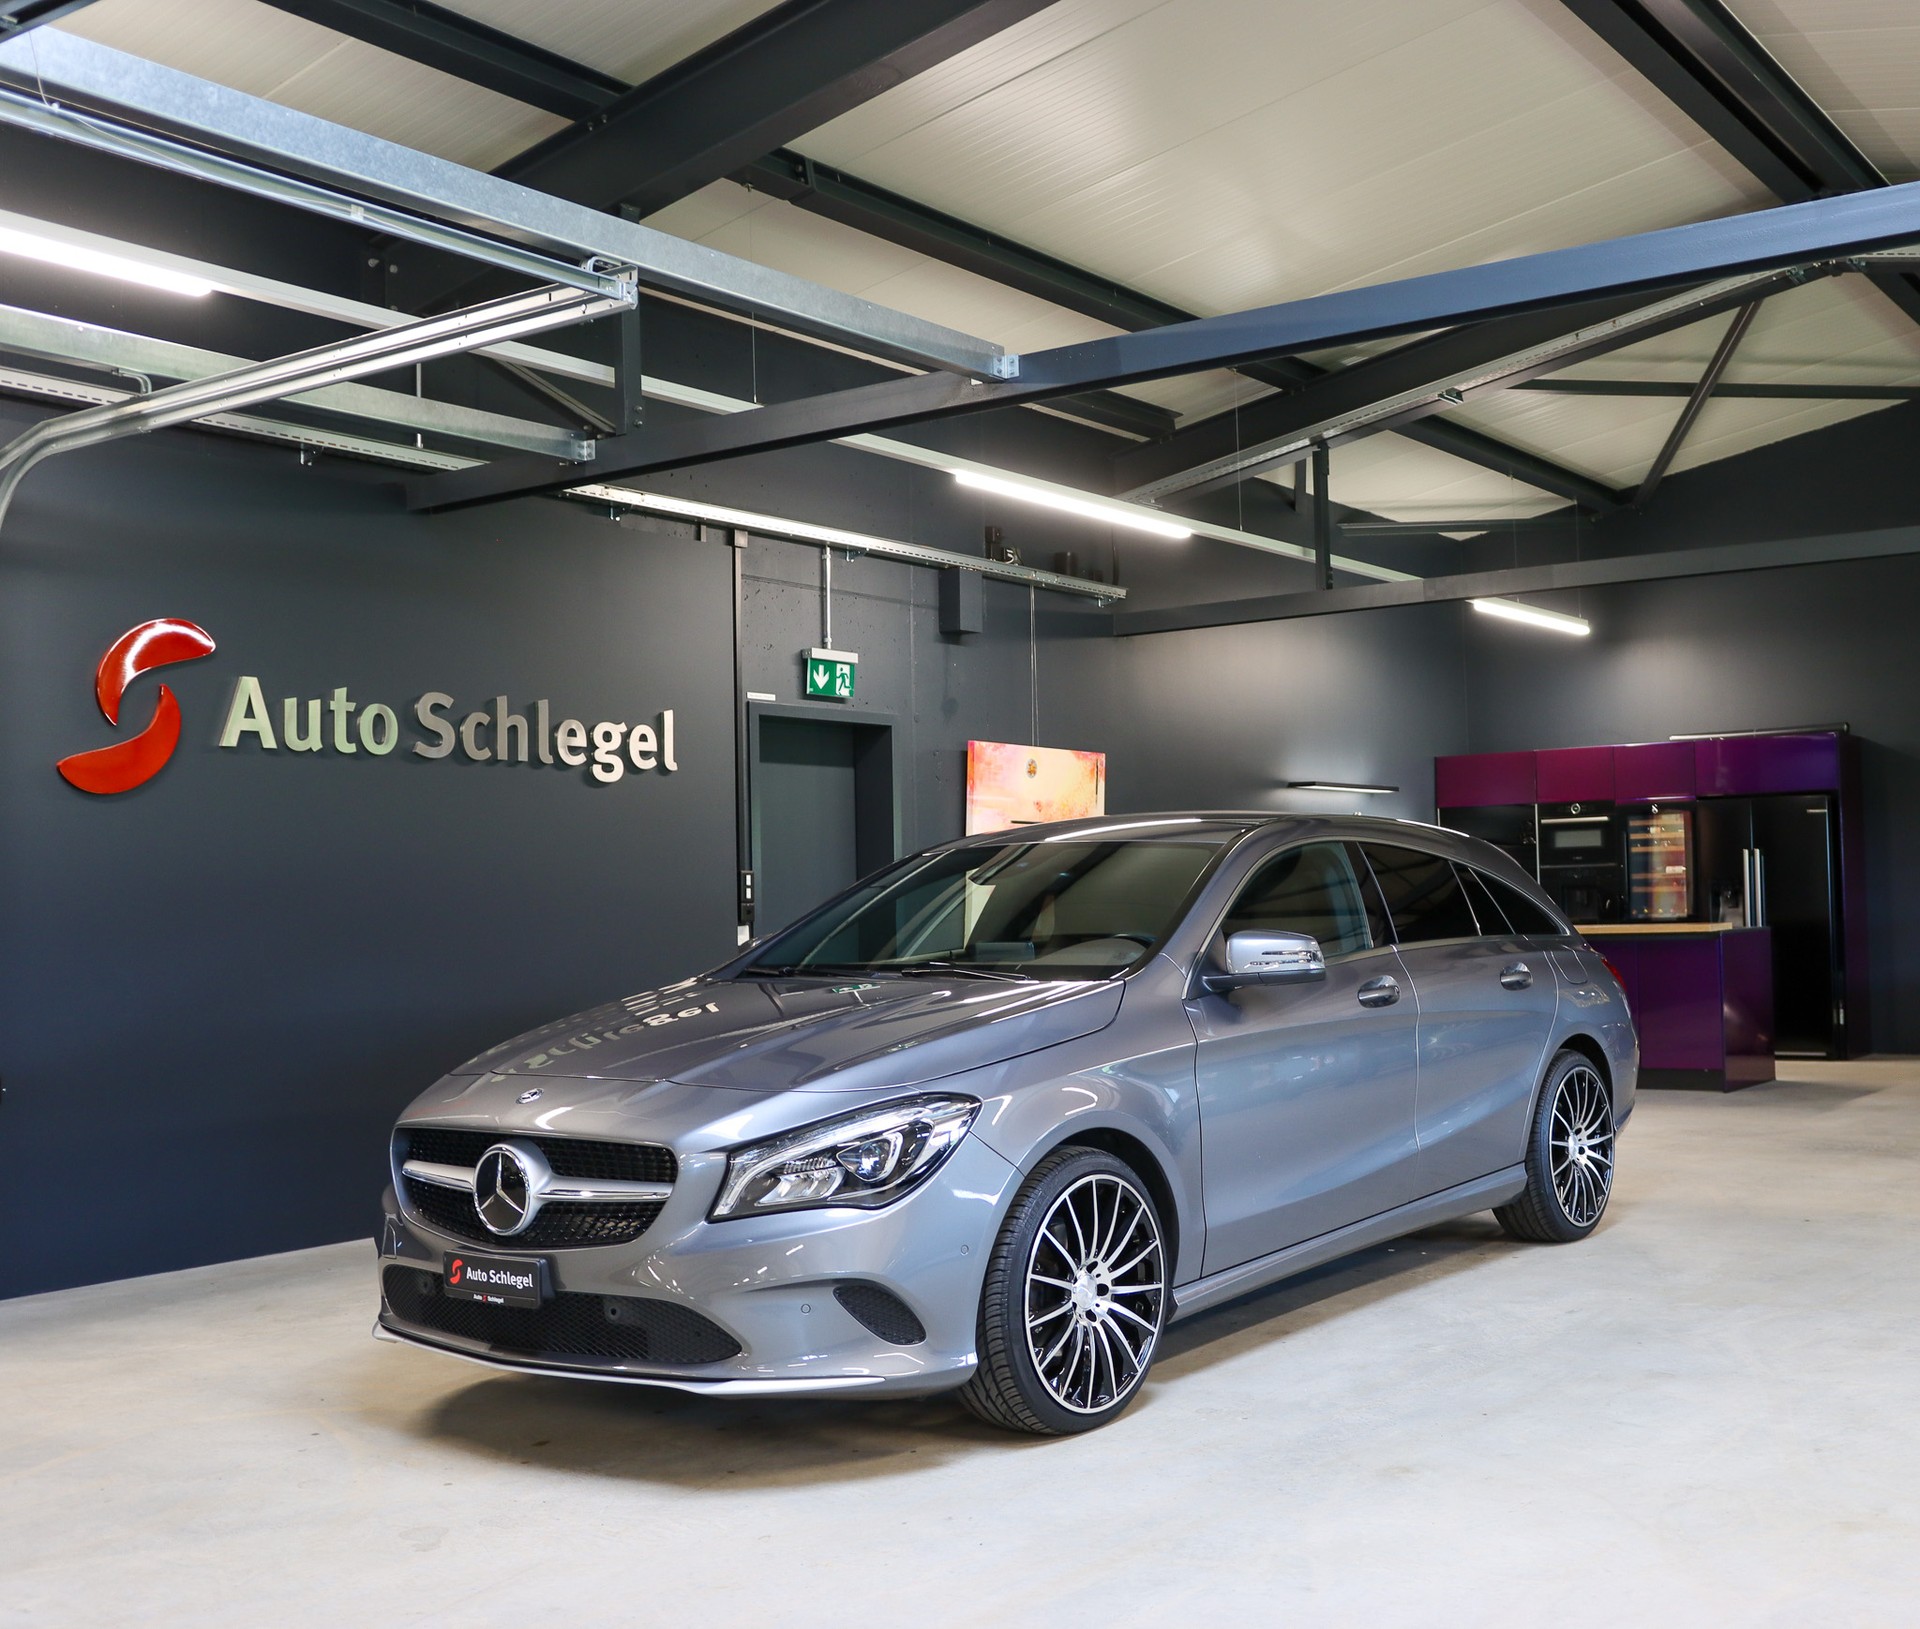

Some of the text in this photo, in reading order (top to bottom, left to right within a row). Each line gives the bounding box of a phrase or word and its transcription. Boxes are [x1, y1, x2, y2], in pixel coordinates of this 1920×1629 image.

[218, 675, 678, 784] Auto Schlegel
[466, 1266, 534, 1290] Auto Schlegel
